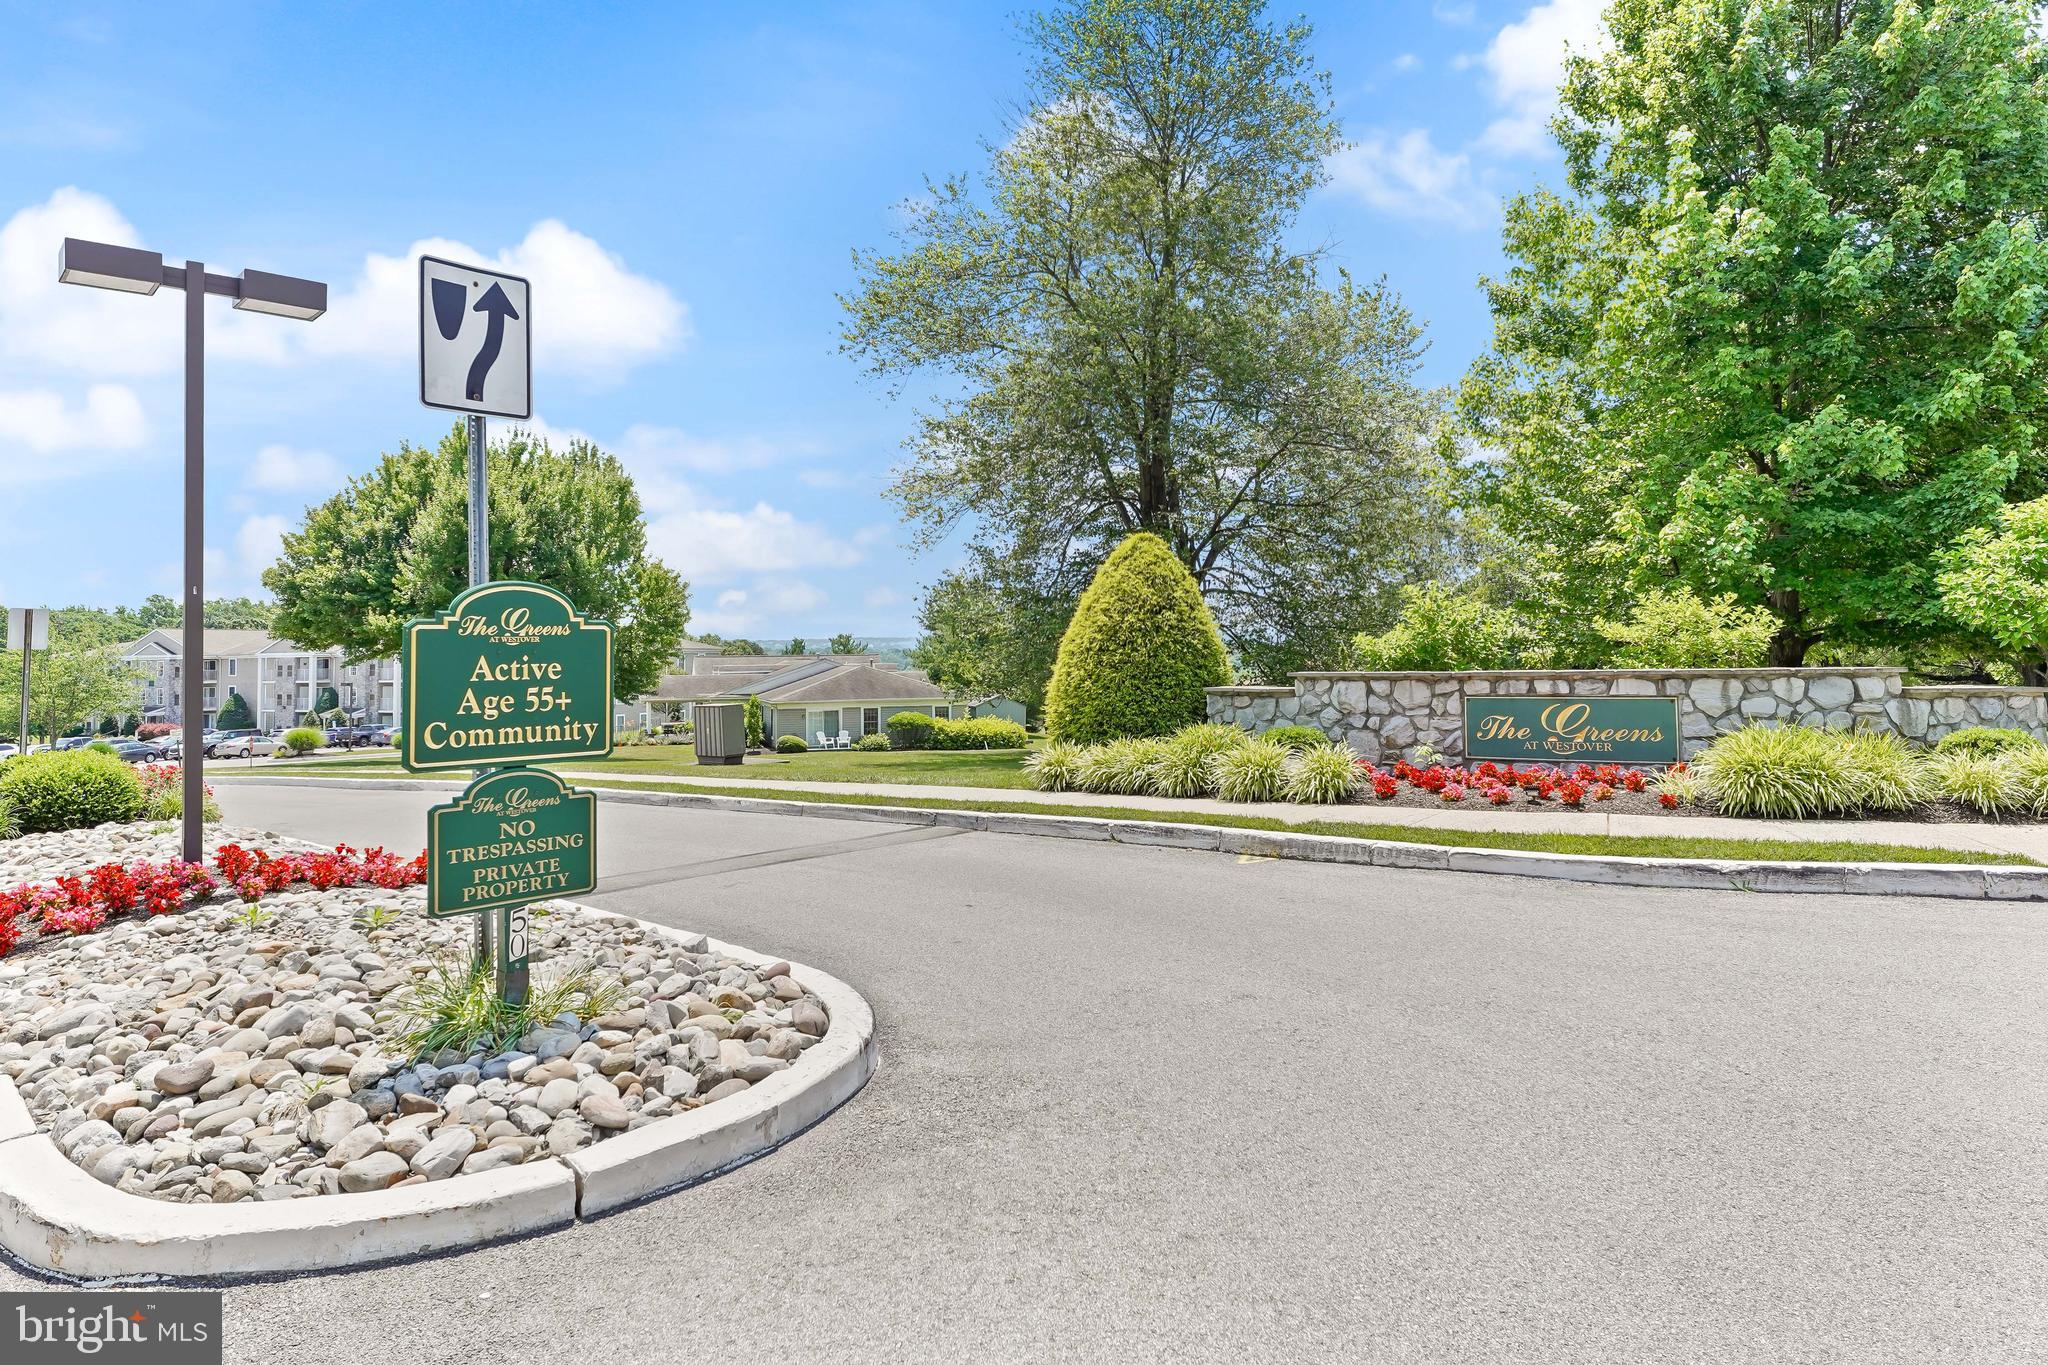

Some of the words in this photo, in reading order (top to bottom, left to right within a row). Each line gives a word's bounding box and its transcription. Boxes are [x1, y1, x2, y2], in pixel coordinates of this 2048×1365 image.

[458, 615, 498, 636] The
[501, 607, 571, 637] Greens
[470, 655, 562, 682] Active
[456, 687, 515, 721] Age
[525, 686, 572, 712] 55+
[423, 716, 599, 750] Community
[1477, 715, 1531, 741] The
[1541, 703, 1665, 743] Greens
[1523, 741, 1538, 751] AT
[1543, 741, 1613, 752] WESTOVER
[472, 797, 503, 815] The
[505, 787, 561, 811] Greens
[499, 819, 536, 839] NO
[446, 833, 584, 865] TRESPASSING
[473, 857, 561, 884] PRIVATE
[462, 872, 570, 903] PROPERTY
[510, 907, 527, 958] 50
